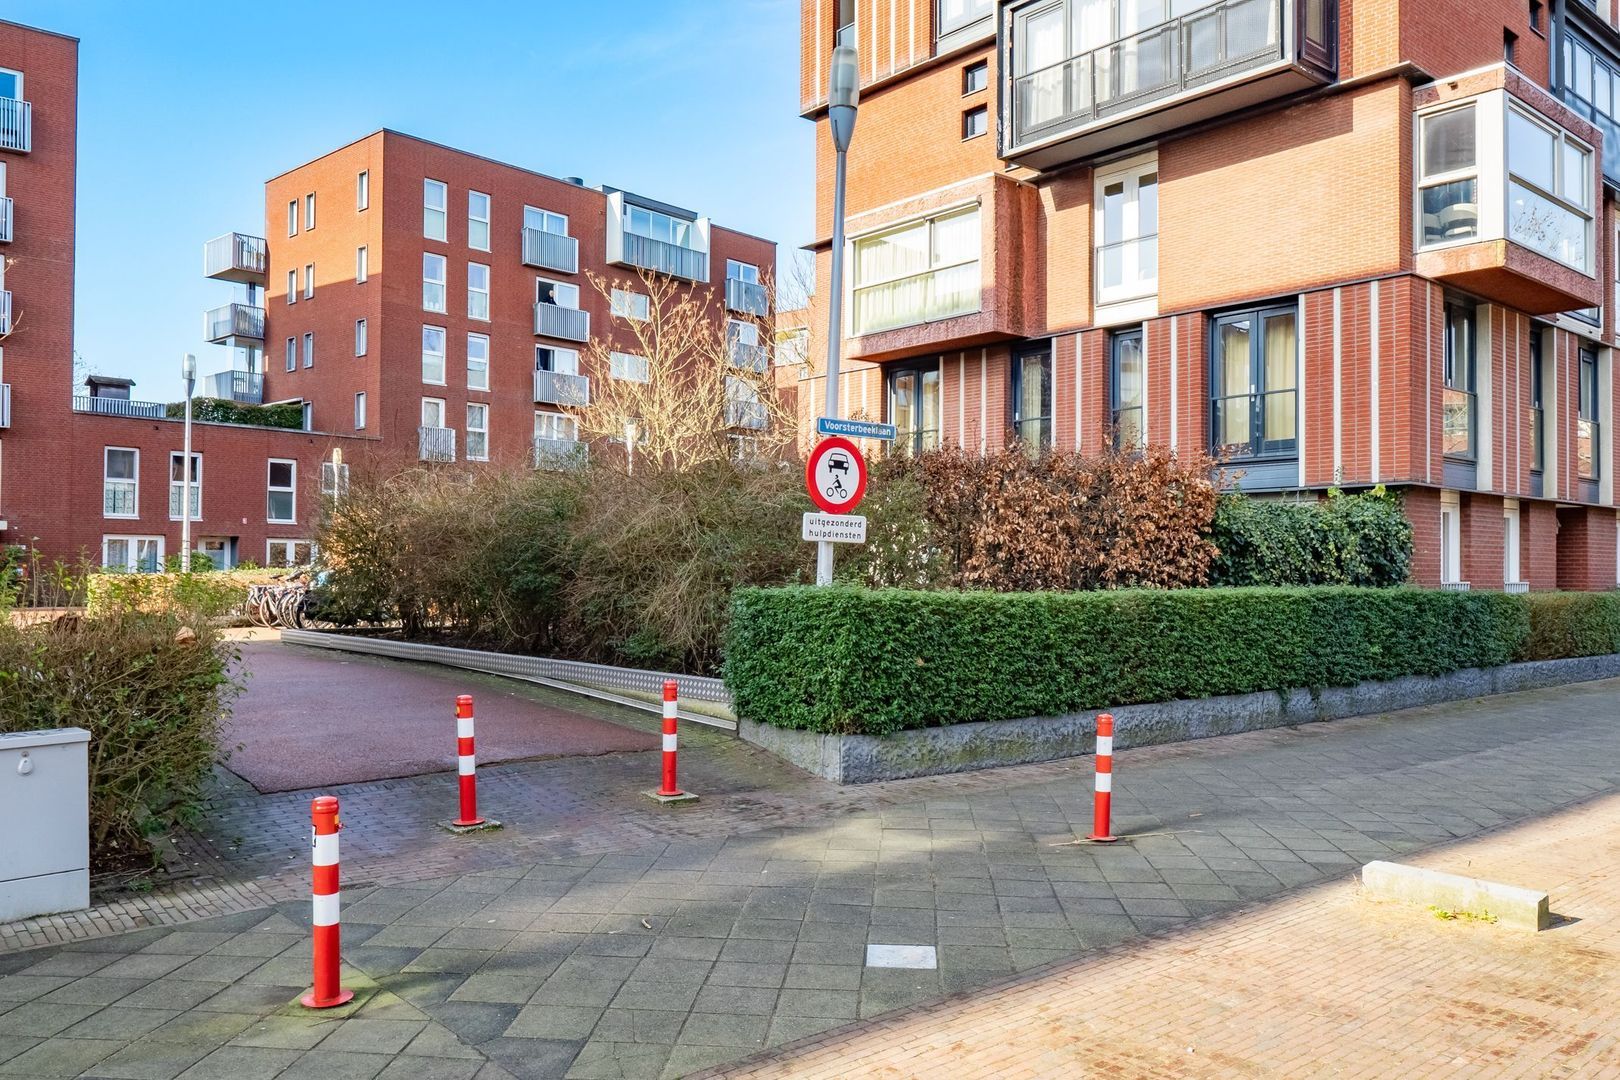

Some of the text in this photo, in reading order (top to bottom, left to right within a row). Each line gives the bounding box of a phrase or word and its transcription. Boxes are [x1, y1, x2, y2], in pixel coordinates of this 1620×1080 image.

[824, 420, 891, 436] Voorsterbeeklaan
[809, 518, 862, 528] uitgezonderd
[808, 530, 862, 539] hulpdiensten
